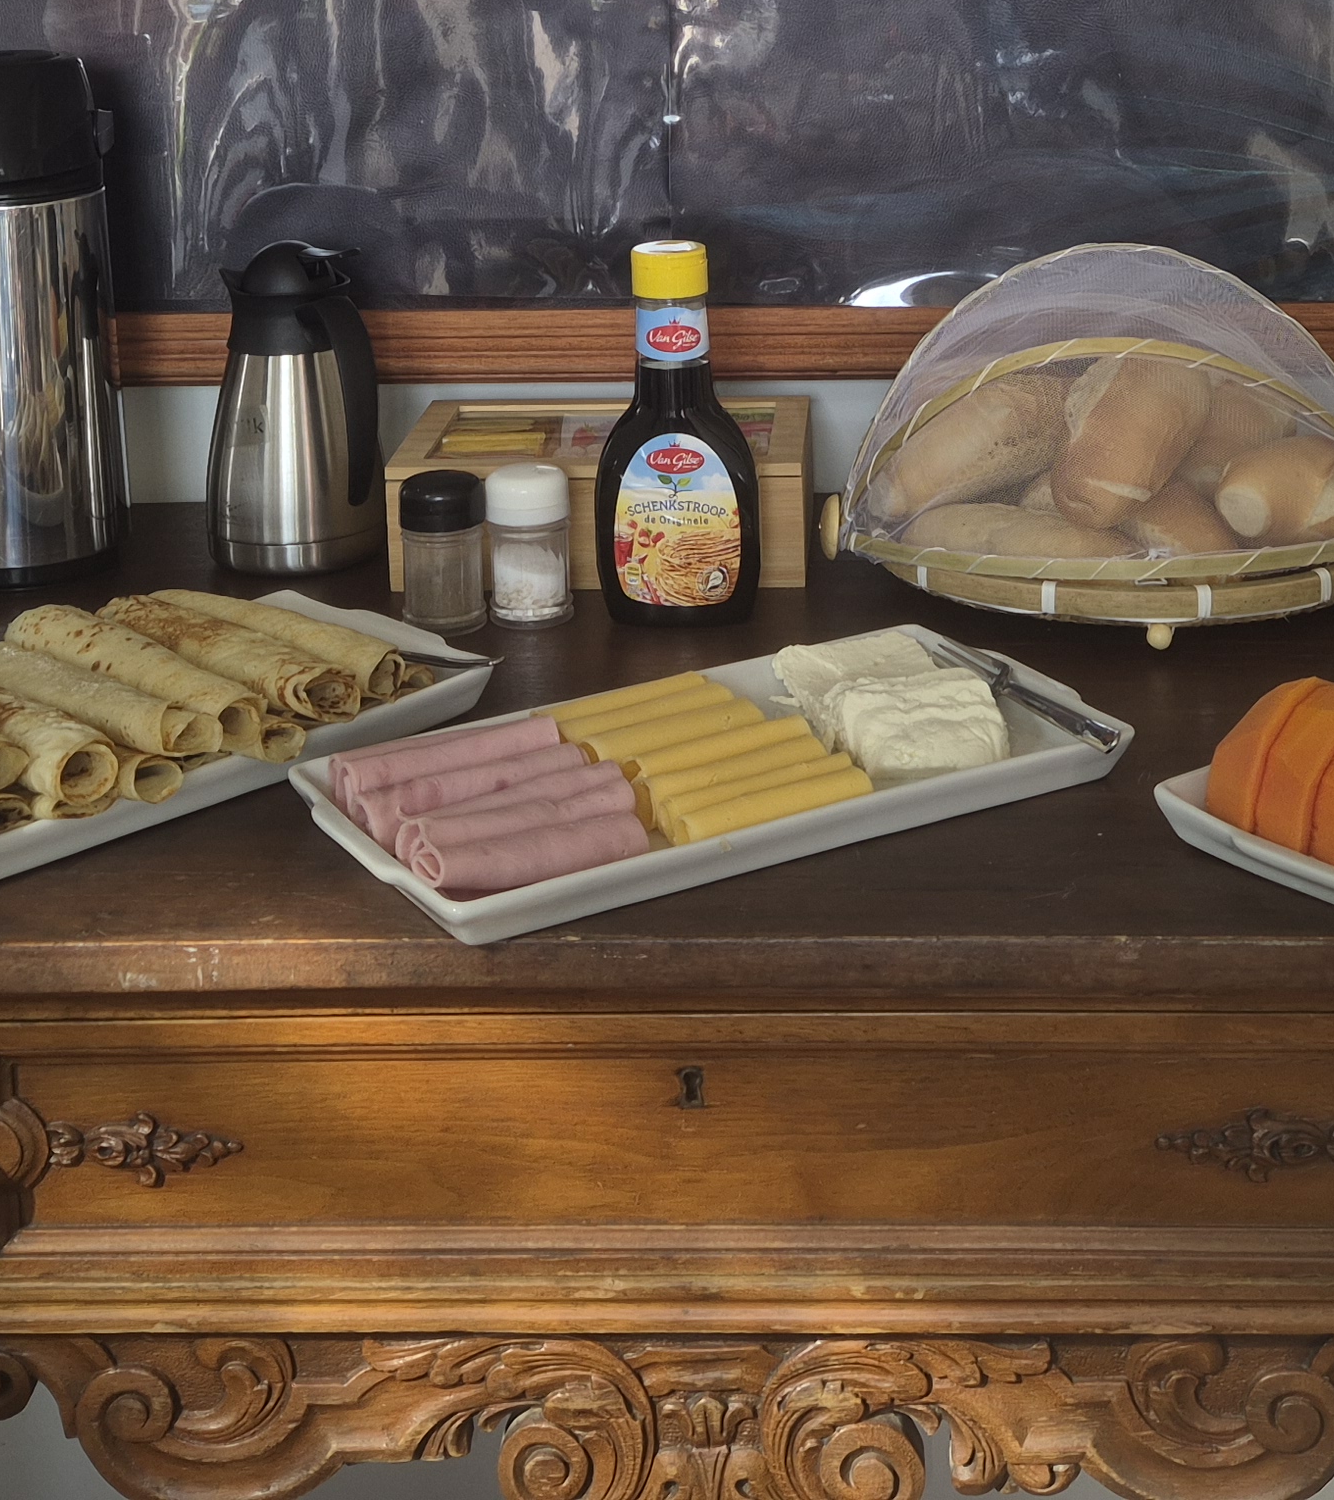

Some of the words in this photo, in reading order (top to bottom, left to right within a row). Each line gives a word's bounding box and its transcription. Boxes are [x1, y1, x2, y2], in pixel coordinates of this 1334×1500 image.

[649, 330, 670, 343] Van
[671, 329, 699, 350] Gilse
[650, 452, 671, 465] Van
[672, 452, 700, 471] Gilse
[627, 500, 727, 518] SCHENKSTROOP
[644, 514, 656, 524] de
[659, 515, 709, 527] Originele
